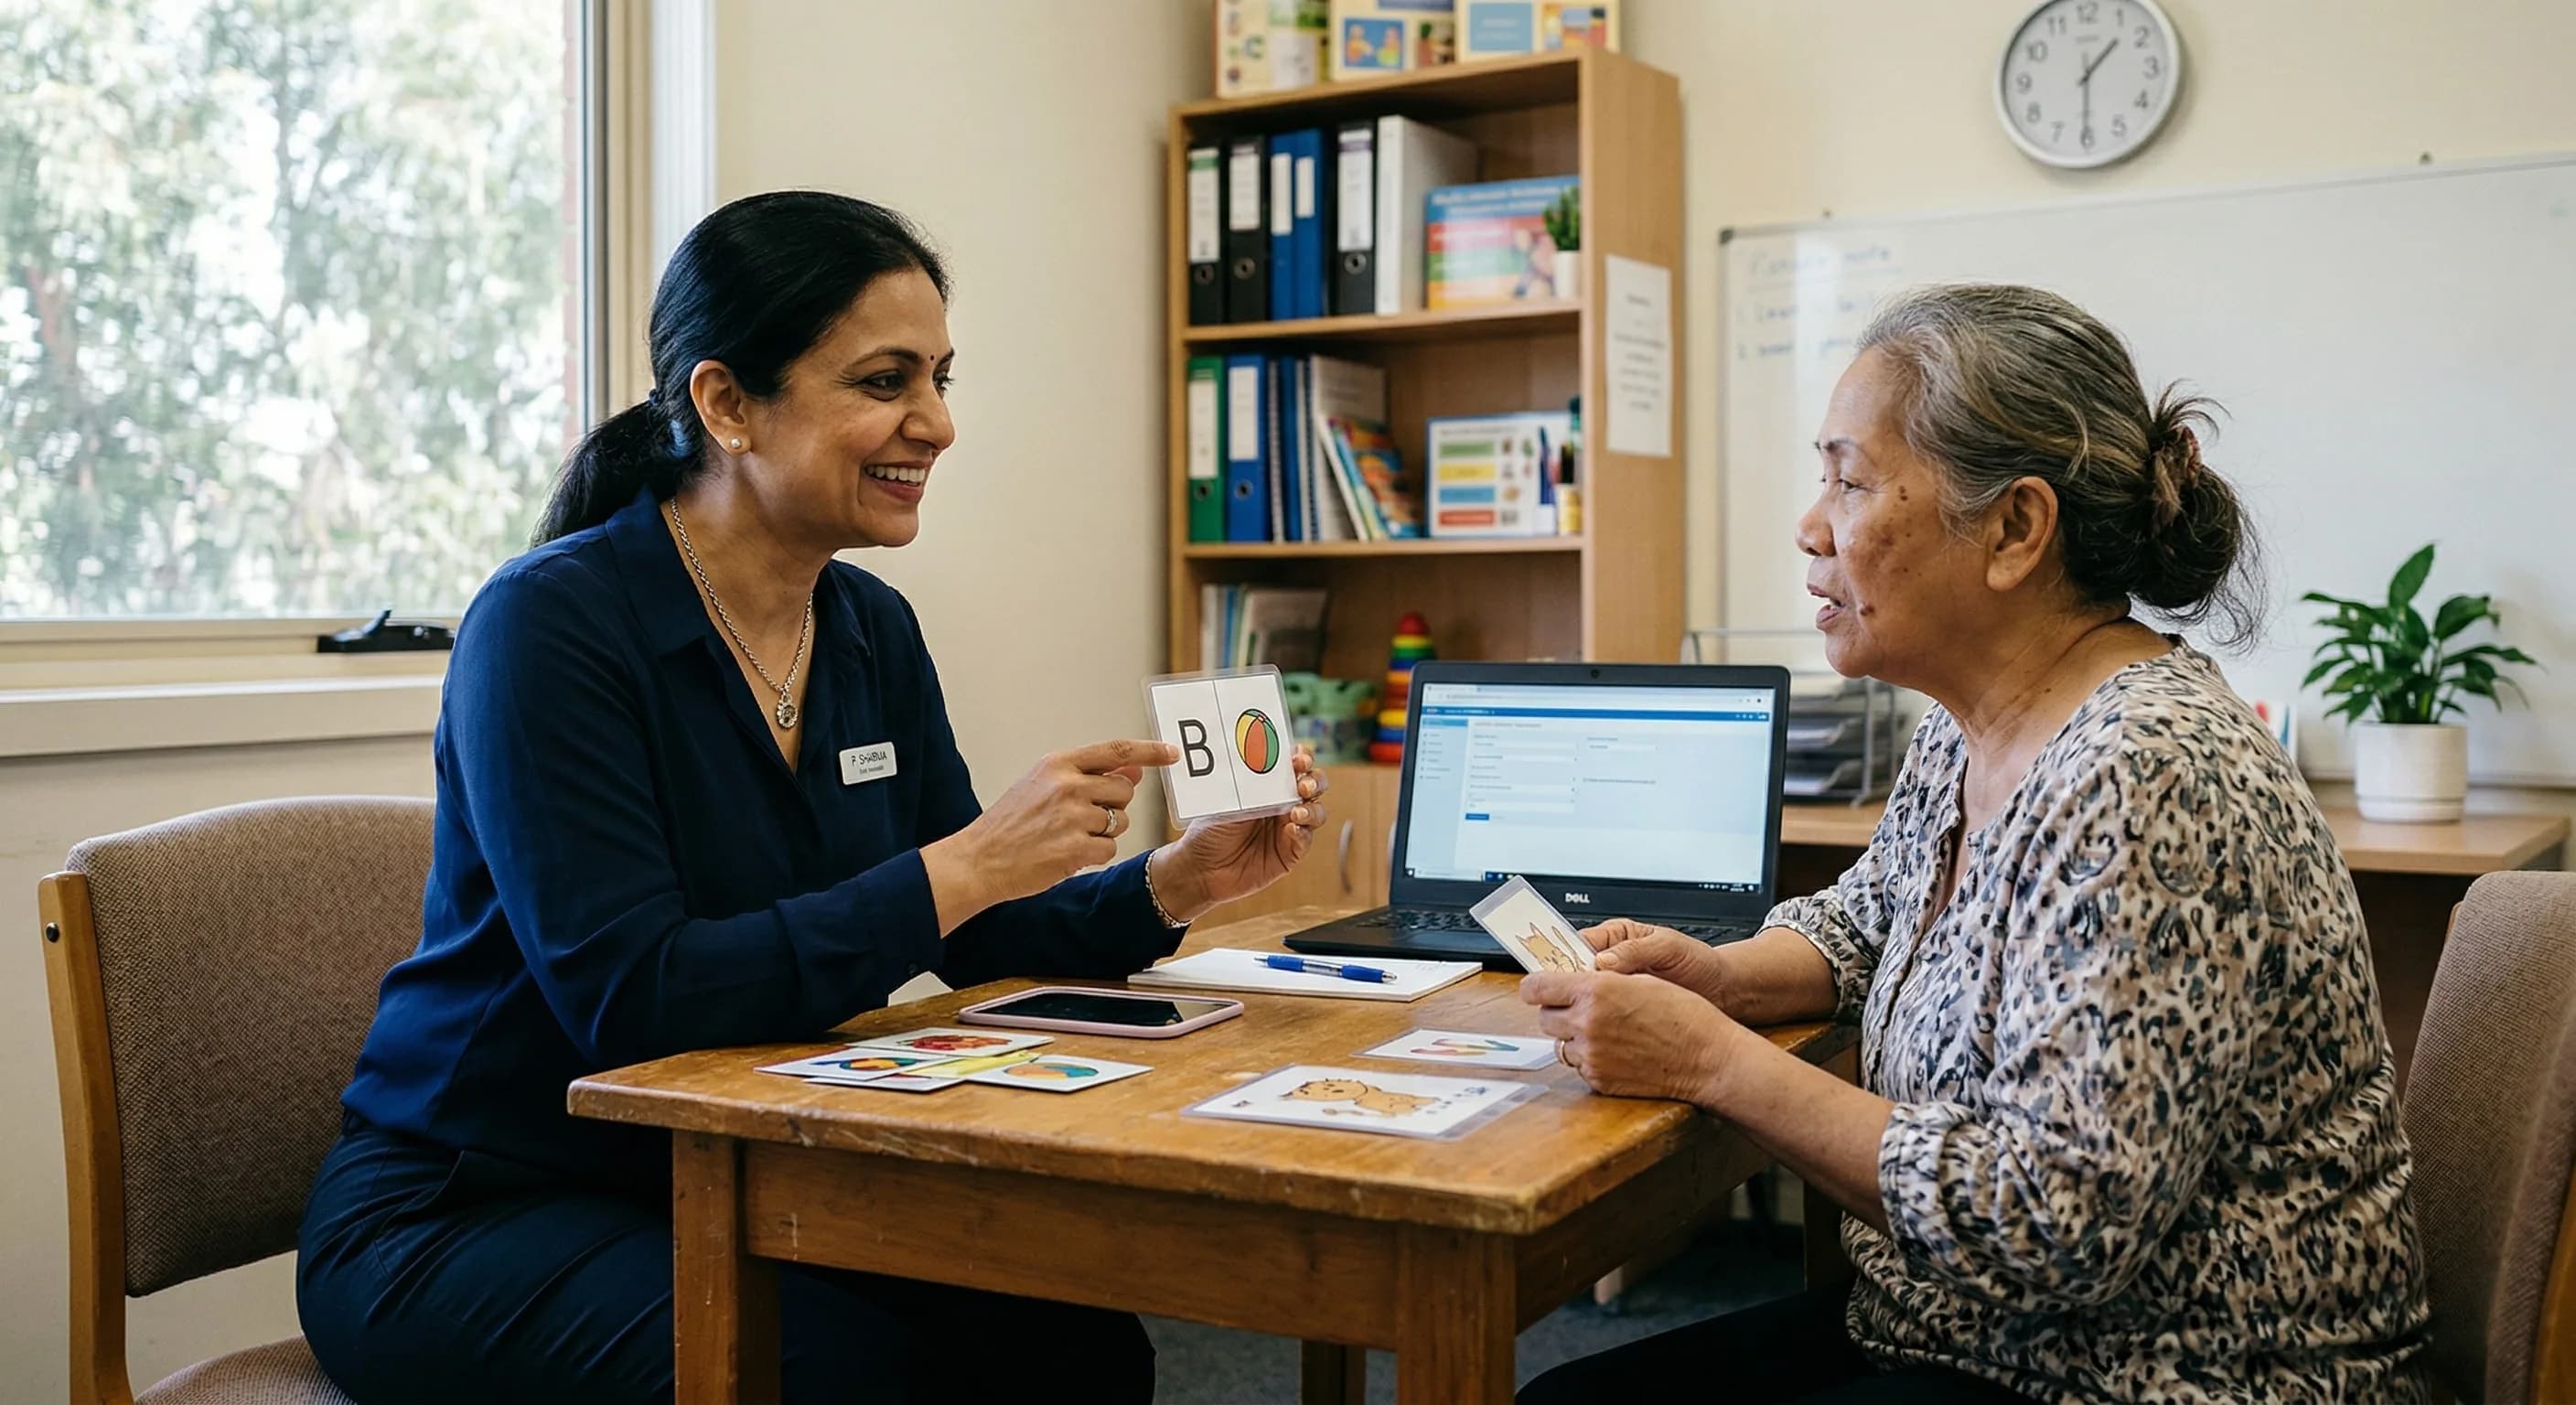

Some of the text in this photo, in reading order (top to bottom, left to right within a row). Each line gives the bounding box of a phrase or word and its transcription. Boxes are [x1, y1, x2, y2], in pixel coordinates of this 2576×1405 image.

[2077, 2, 2098, 24] 12
[2115, 8, 2124, 27] 1
[2047, 16, 2066, 36] 11
[2134, 27, 2150, 48] 2
[2026, 40, 2047, 62] 10
[2143, 57, 2160, 80] 3
[2016, 72, 2032, 94] 9
[2134, 90, 2149, 109] 4
[2026, 102, 2041, 123] 8
[2051, 121, 2065, 143] 7
[2111, 115, 2127, 136] 5
[2080, 126, 2095, 148] 6
[1178, 719, 1215, 778] B
